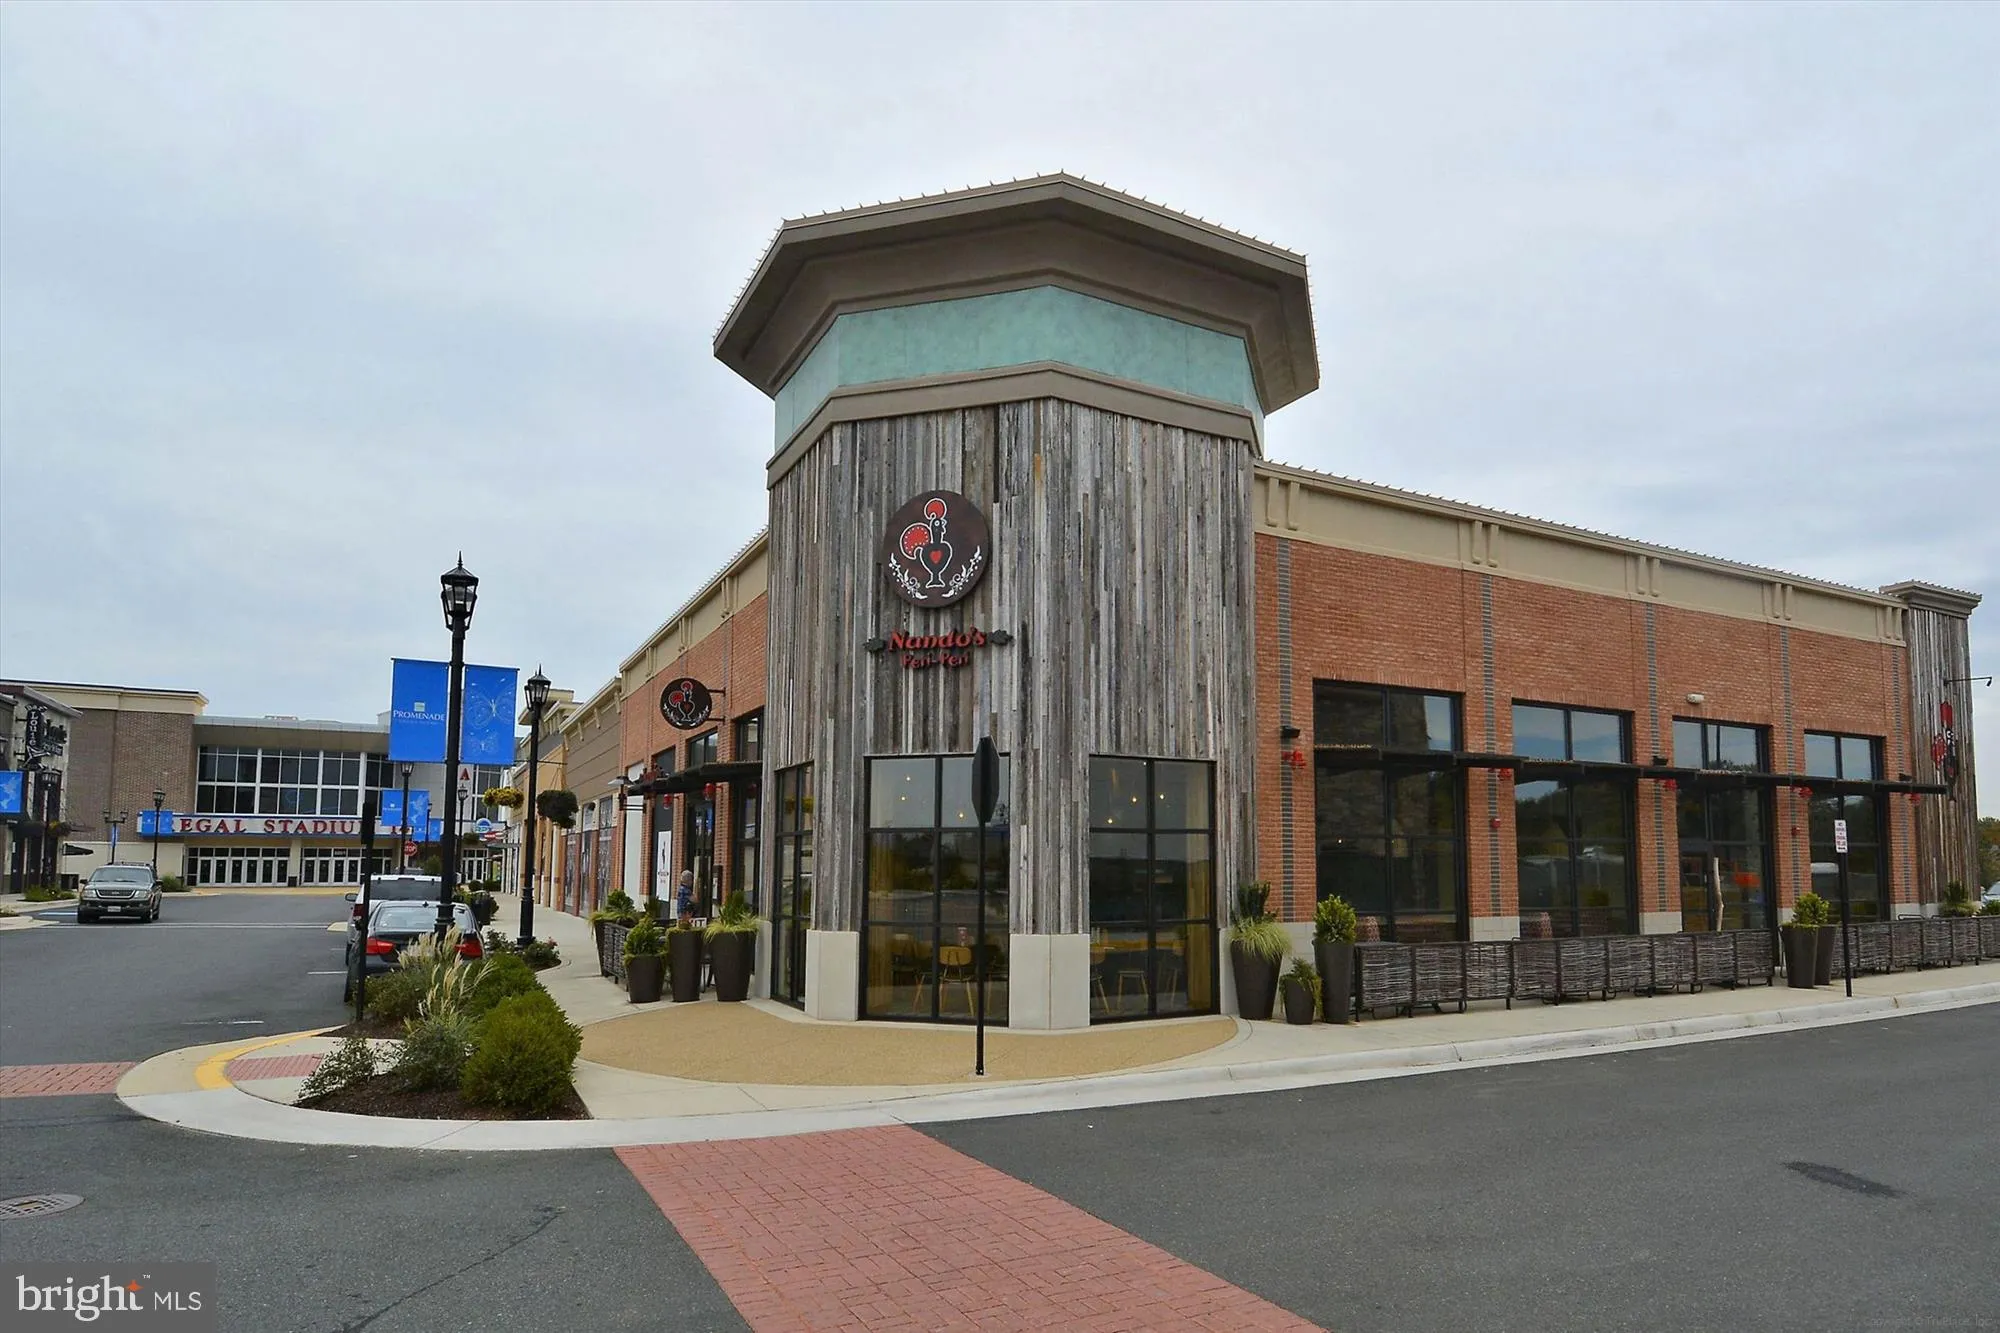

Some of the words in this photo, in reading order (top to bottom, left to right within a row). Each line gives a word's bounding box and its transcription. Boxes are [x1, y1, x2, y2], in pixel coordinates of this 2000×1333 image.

[888, 625, 987, 652] Nando's
[393, 710, 446, 721] PROMENADE
[172, 819, 246, 833] EGAL
[263, 819, 363, 834] STADIU
